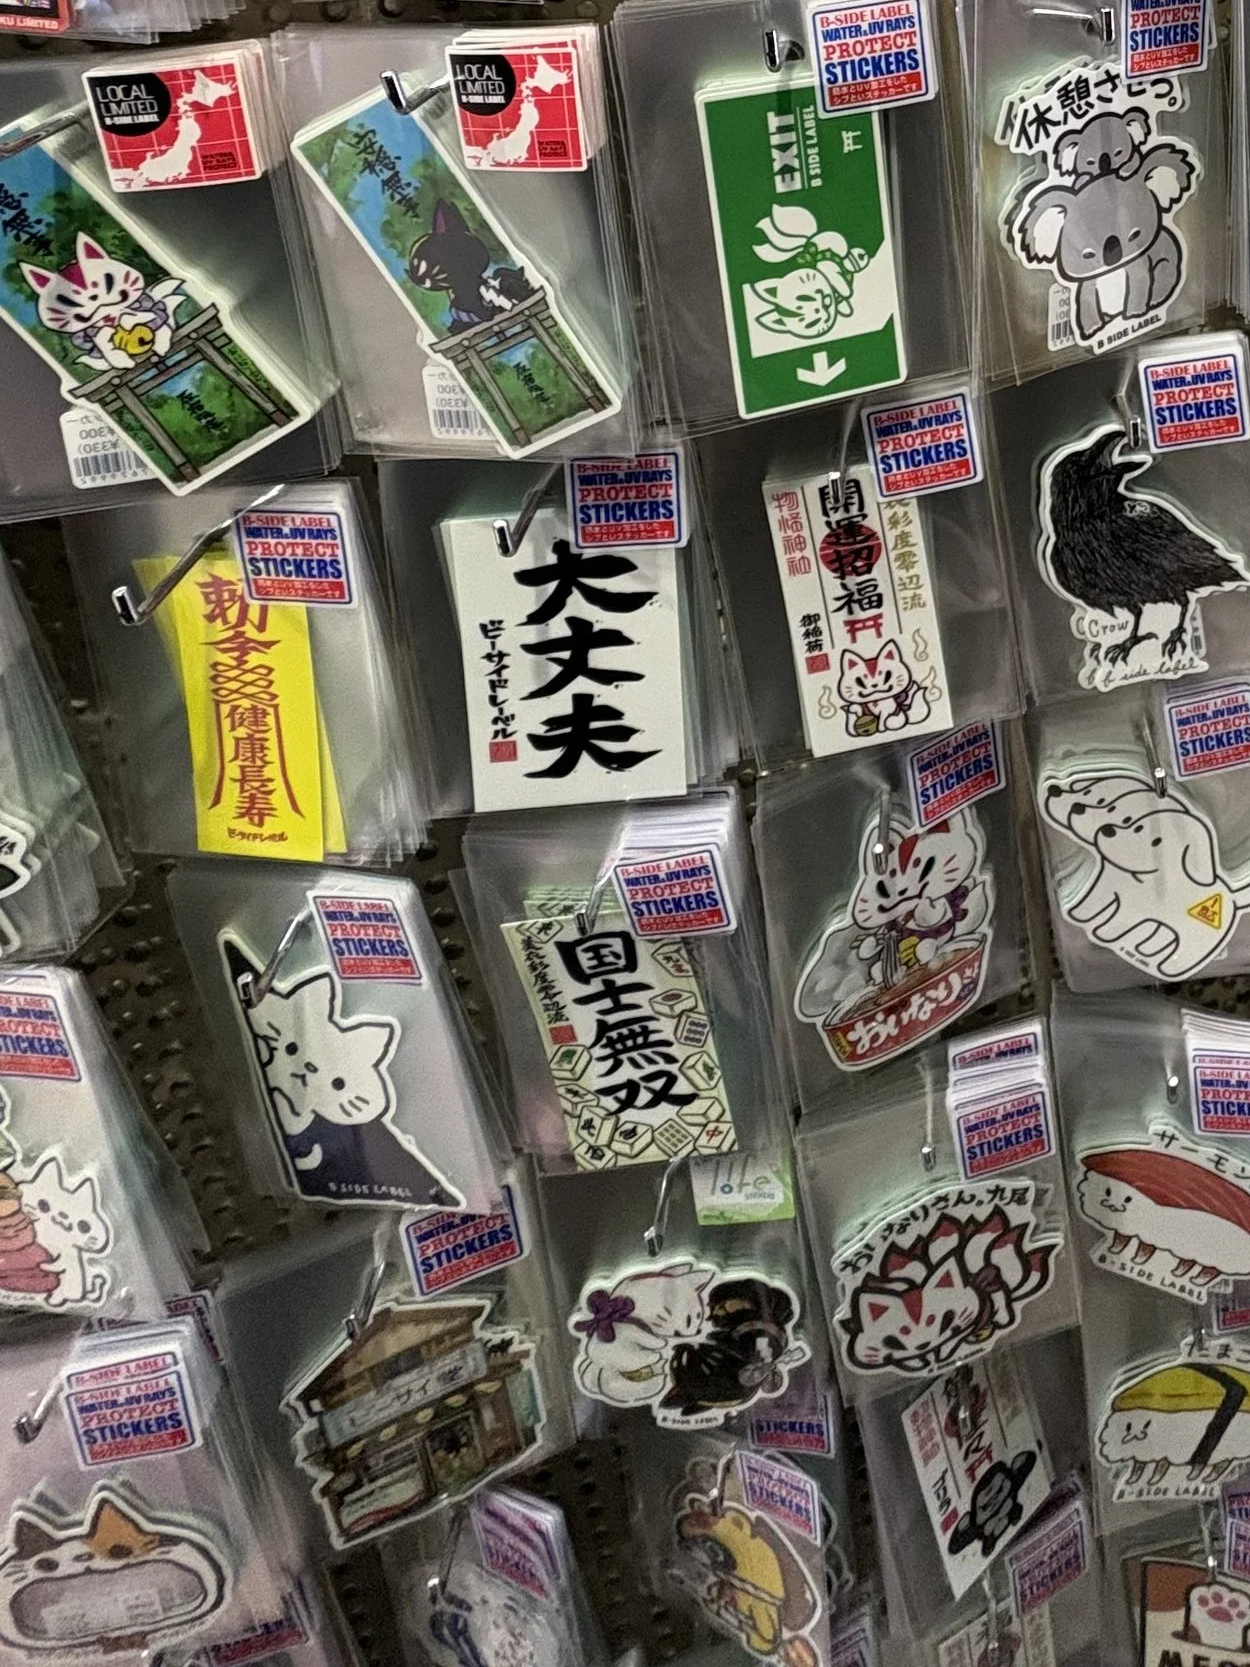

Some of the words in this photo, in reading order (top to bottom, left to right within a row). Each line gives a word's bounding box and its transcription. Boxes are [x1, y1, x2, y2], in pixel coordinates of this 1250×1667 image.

[822, 32, 917, 60] PROTECT
[1130, 24, 1200, 52] STICKERS
[456, 63, 501, 82] LOCAL
[825, 49, 920, 86] STICKERS
[96, 85, 154, 102] LOCAL
[459, 80, 506, 95] LIMITED
[101, 99, 158, 118] LIMITED
[769, 112, 802, 194] EXIT
[1156, 401, 1237, 425] STICKERS
[880, 443, 967, 472] STICKERS
[580, 499, 674, 523] STICKERS
[818, 479, 884, 615] 開運招福
[250, 556, 344, 580] STICKERS
[1088, 618, 1129, 638] Crow
[514, 540, 662, 779] 大丈夫
[479, 620, 517, 741] ビーサイドレーベル
[224, 705, 278, 828] 健康長寿
[632, 891, 720, 916] STICKERS
[333, 936, 408, 958] STICKERS
[554, 931, 698, 1115] 国士無双
[1160, 1277, 1204, 1301] LABEL
